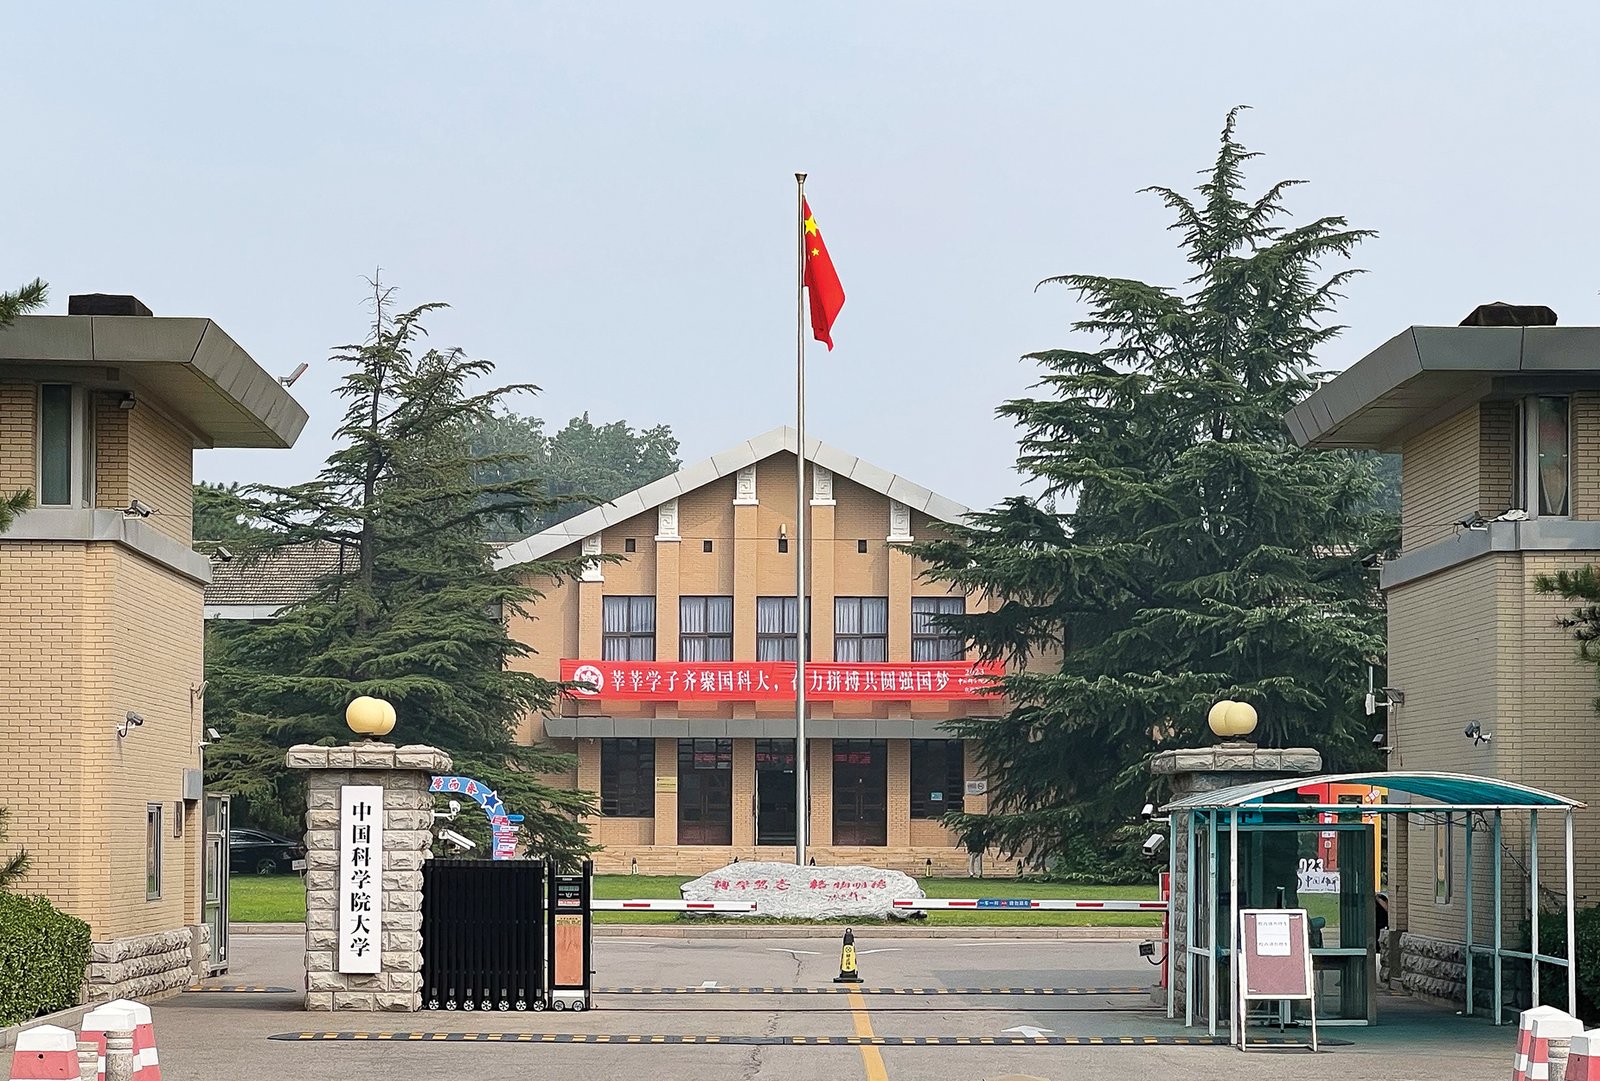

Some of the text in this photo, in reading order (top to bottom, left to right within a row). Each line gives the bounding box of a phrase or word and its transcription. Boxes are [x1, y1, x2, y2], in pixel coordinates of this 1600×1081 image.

[350, 801, 371, 957] 中国科学院大学
